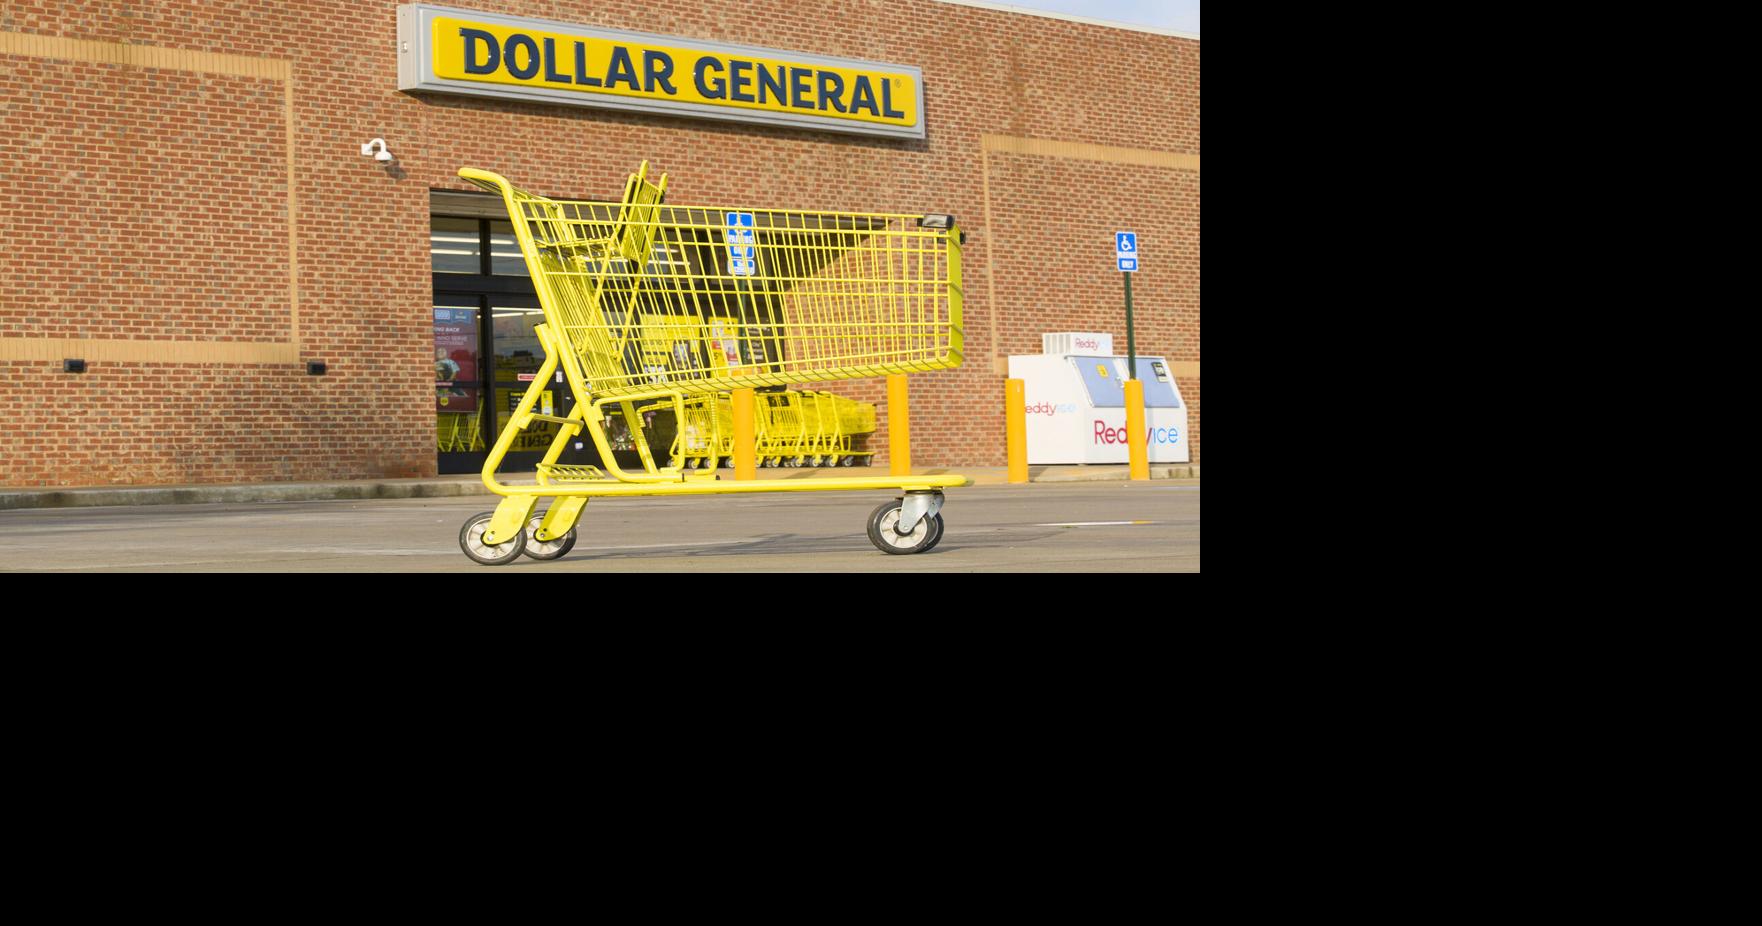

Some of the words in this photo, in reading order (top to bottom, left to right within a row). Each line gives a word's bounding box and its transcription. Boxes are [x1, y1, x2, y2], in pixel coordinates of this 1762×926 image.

[459, 27, 676, 96] DOLLAR
[693, 56, 905, 120] GENERAL
[1075, 337, 1098, 351] Reddy
[1025, 402, 1056, 416] eddy
